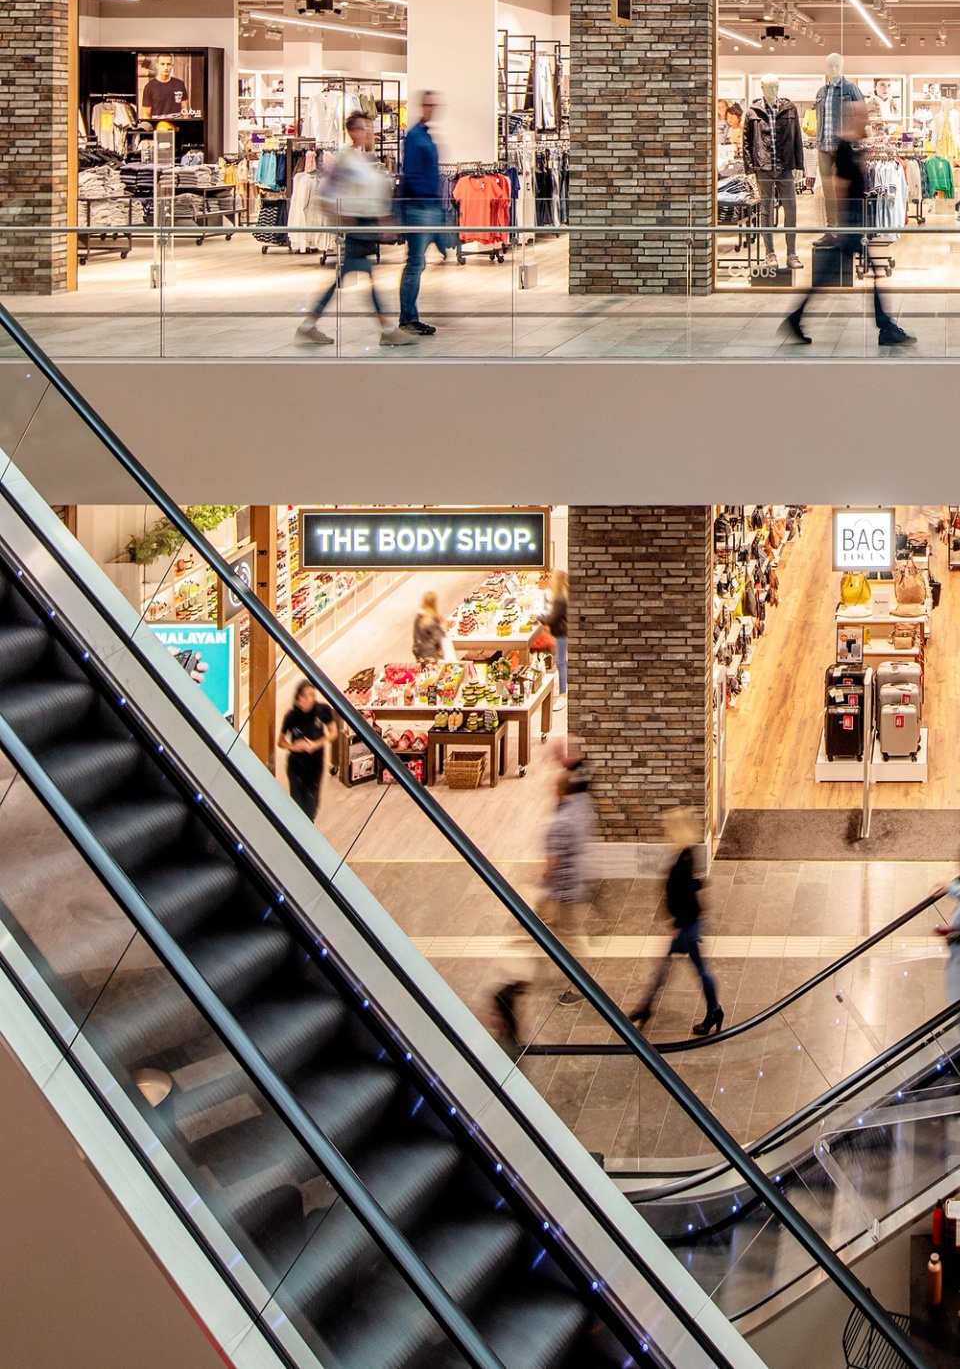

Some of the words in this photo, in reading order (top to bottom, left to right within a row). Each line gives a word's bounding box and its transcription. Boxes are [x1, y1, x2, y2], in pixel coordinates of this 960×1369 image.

[181, 108, 202, 116] Cubus
[728, 263, 777, 278] Cubus
[317, 528, 370, 552] THE
[378, 528, 451, 552] BODY
[842, 528, 885, 552] BAG
[155, 631, 227, 645] MALAYAN
